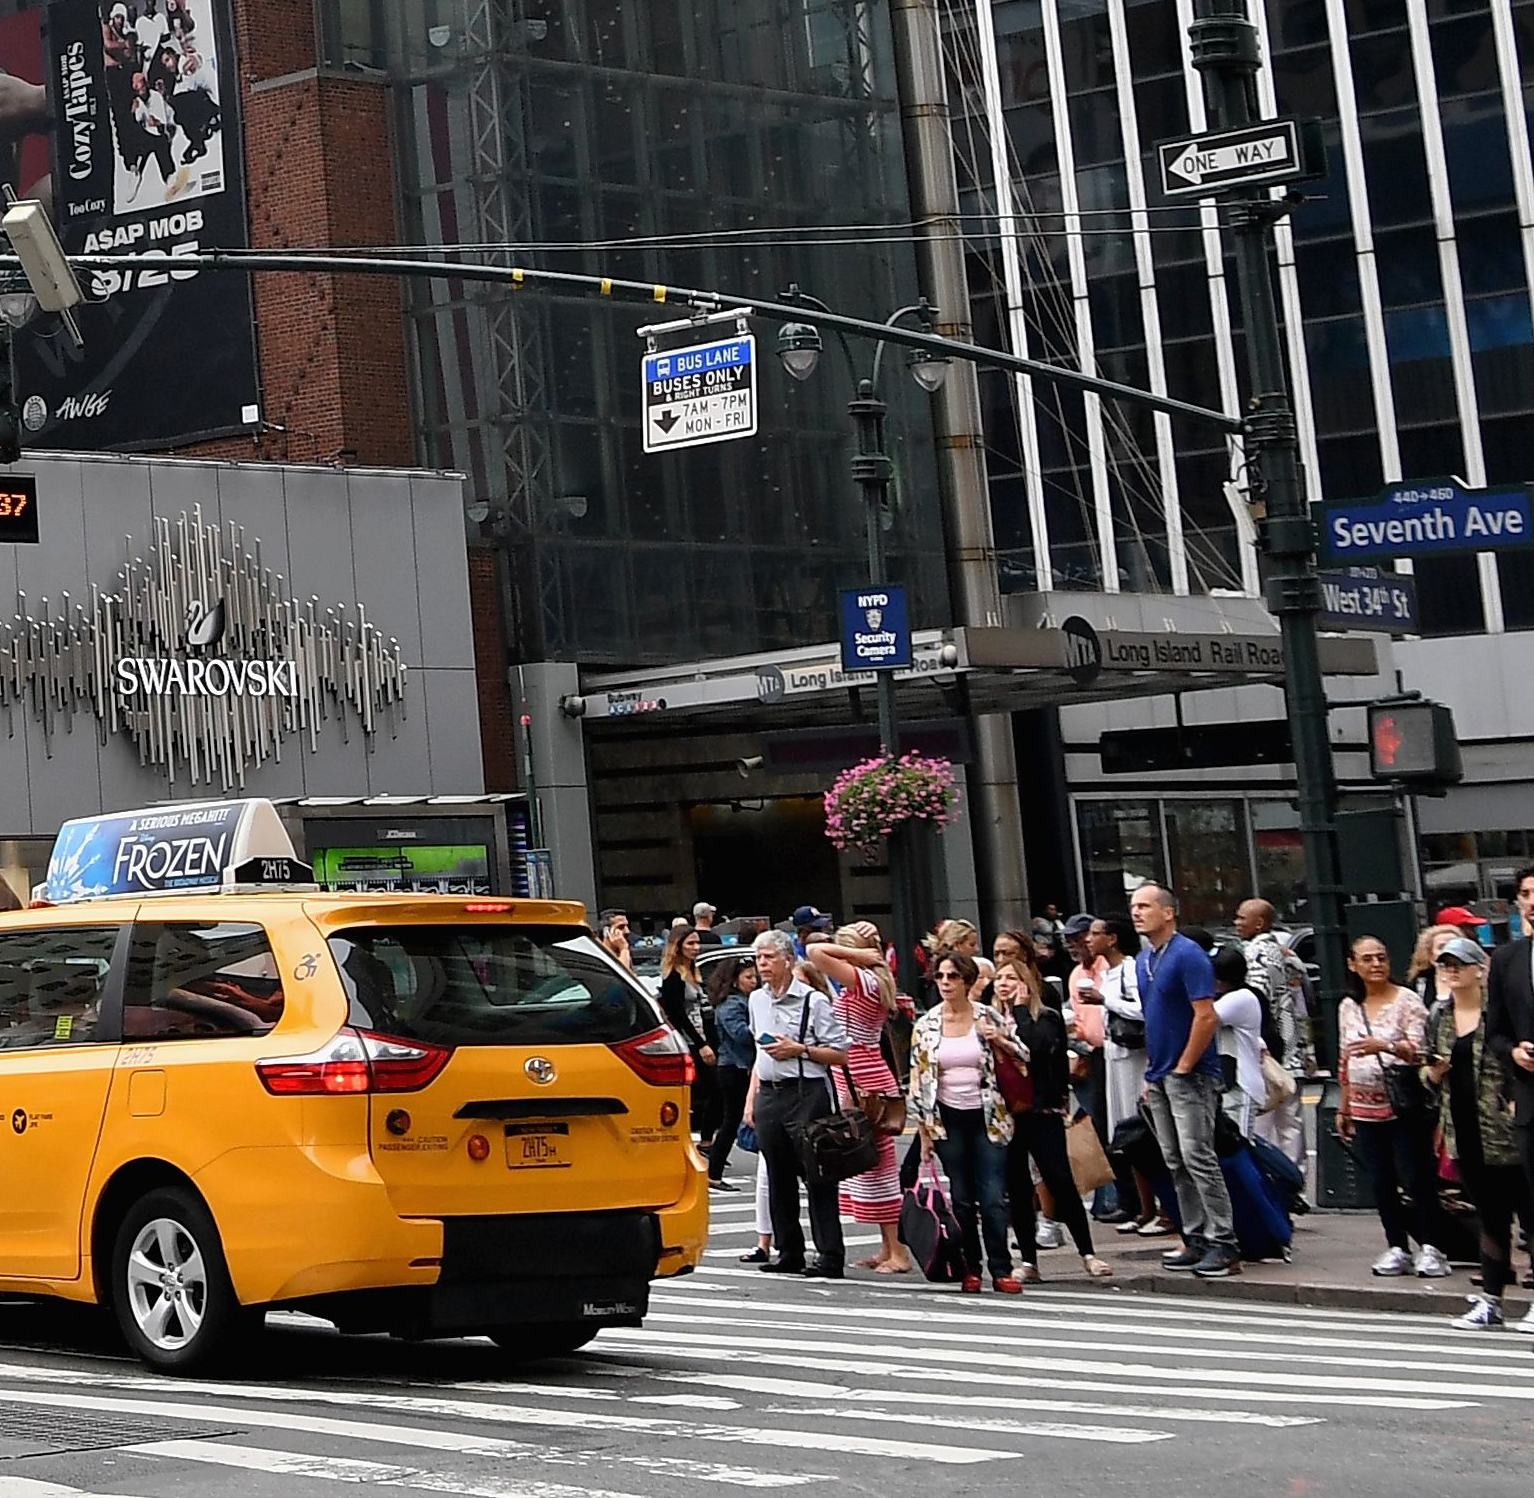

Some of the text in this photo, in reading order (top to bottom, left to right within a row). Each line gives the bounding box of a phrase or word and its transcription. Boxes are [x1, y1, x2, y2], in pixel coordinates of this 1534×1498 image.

[1183, 140, 1275, 174] ONE WAY
[84, 210, 204, 255] A$AP MOB
[677, 346, 740, 372] BUS LANE
[653, 365, 744, 395] BUSES ONLY
[674, 389, 701, 400] RIGHT
[703, 382, 733, 395] TURNS
[55, 389, 112, 419] AWGE
[683, 400, 709, 417] 7AM
[721, 392, 747, 410] 7PM
[685, 416, 712, 434] MON
[725, 411, 745, 427] FRI
[1334, 506, 1524, 550] Seventh Ave
[857, 594, 888, 607] NYPD
[1321, 584, 1410, 619] West 34th St
[854, 631, 897, 646] Security
[856, 645, 897, 658] Camera
[1105, 639, 1149, 667] Long
[1153, 640, 1201, 665] Island
[1212, 641, 1243, 666] Rail
[1248, 643, 1285, 667] Roa
[117, 656, 299, 697] SWAROVSKI
[790, 671, 827, 691] Long
[913, 656, 942, 675] Roa
[129, 820, 137, 832] A
[138, 814, 181, 832] SERIOUS
[113, 832, 228, 890] FROZEN
[262, 859, 291, 880] 2H75
